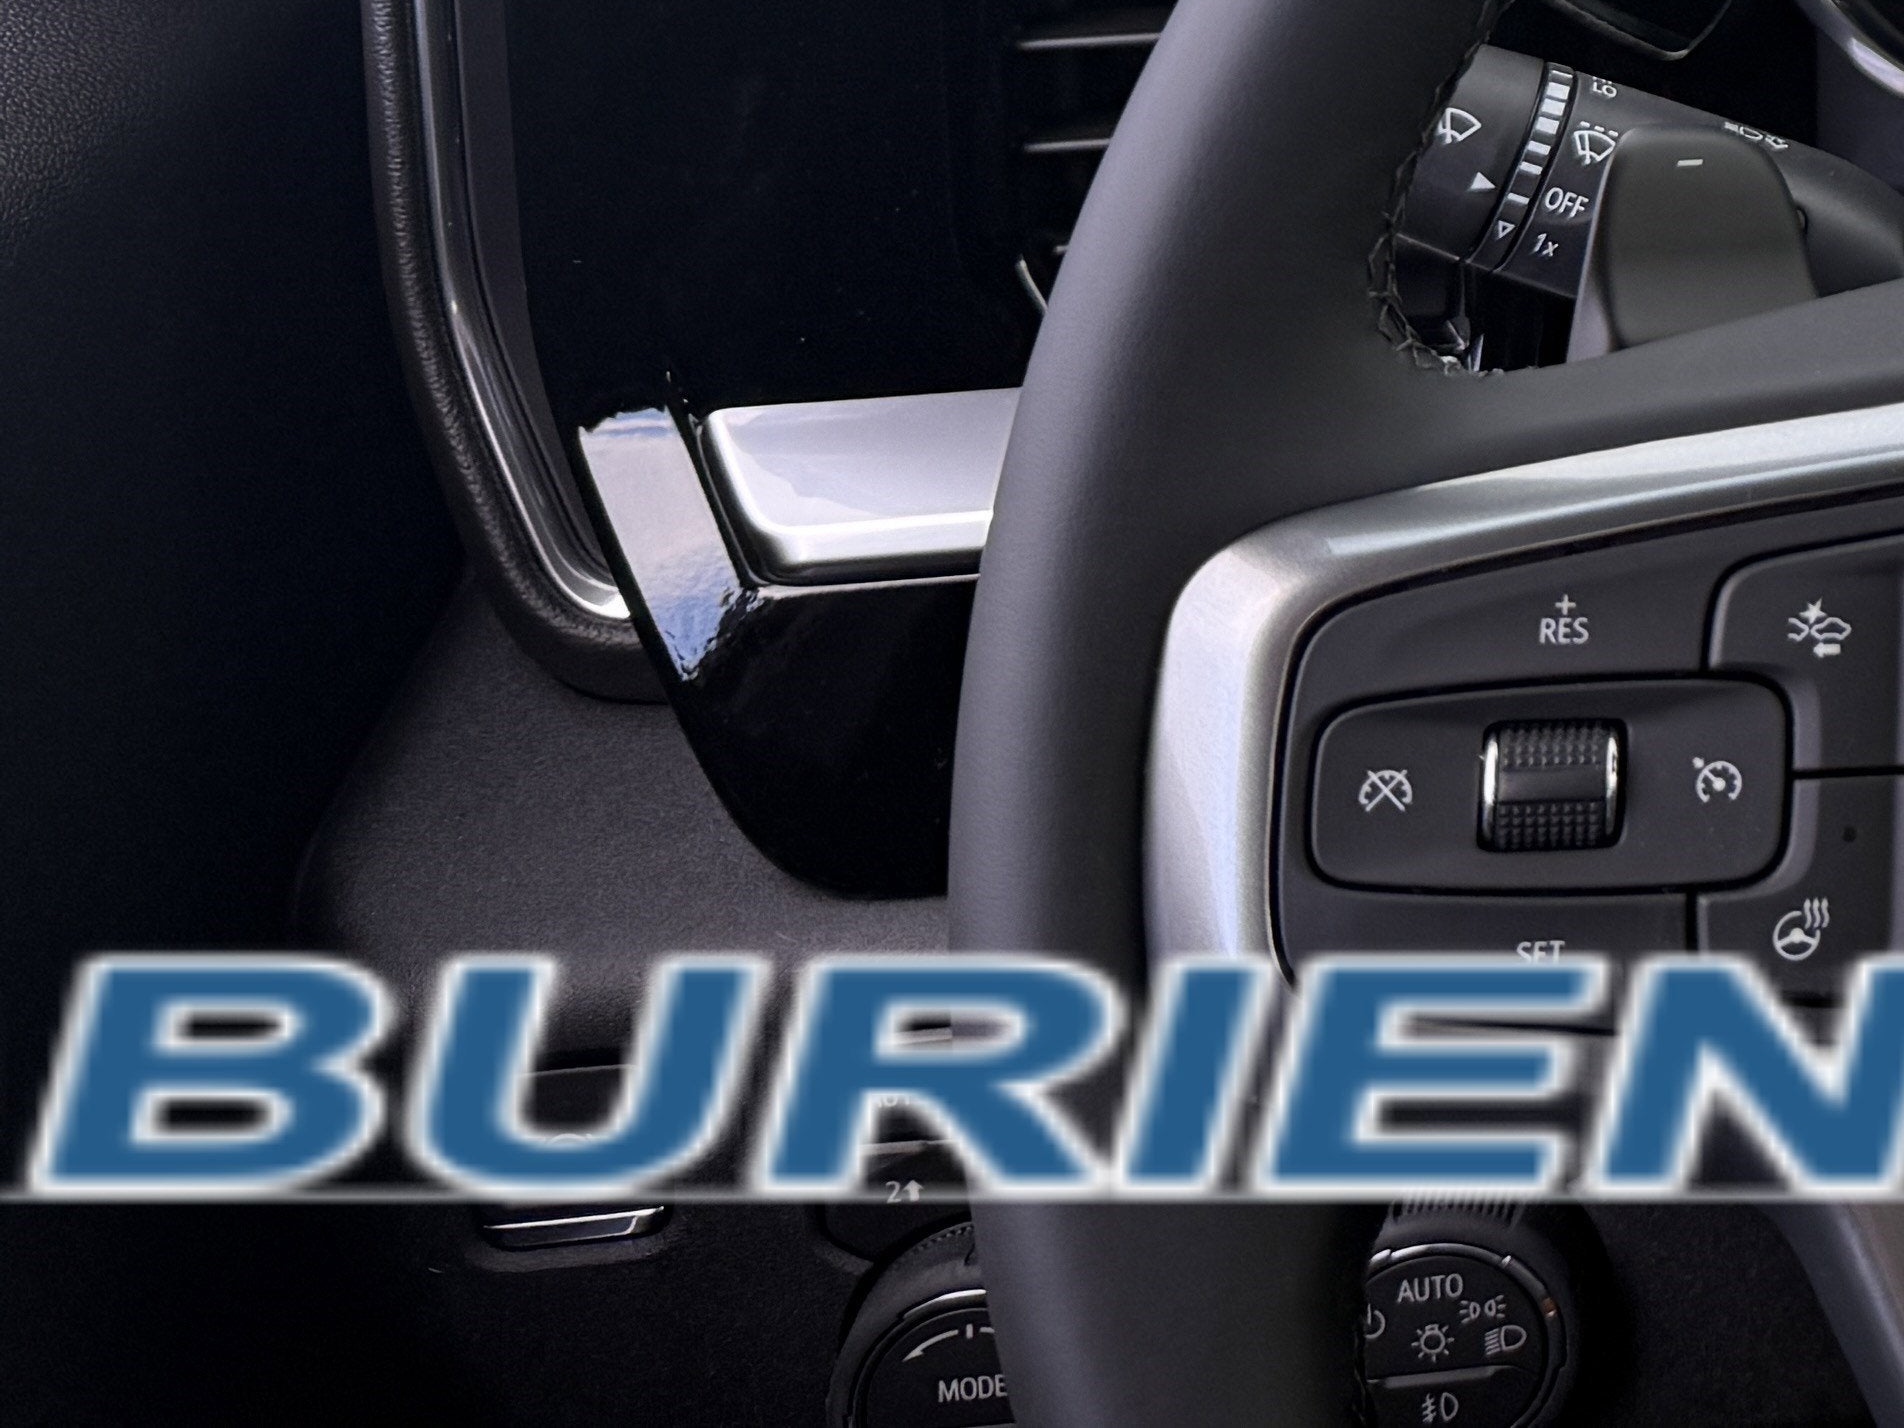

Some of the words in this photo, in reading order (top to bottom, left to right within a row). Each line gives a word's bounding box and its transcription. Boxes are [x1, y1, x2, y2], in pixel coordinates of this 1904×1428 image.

[1592, 81, 1618, 99] LO
[1544, 187, 1590, 219] OFF
[1533, 233, 1559, 257] 1x
[1539, 618, 1590, 645] RES
[1516, 941, 1566, 964] SET
[1396, 1273, 1465, 1303] AUTO
[937, 1373, 1009, 1405] MODE
